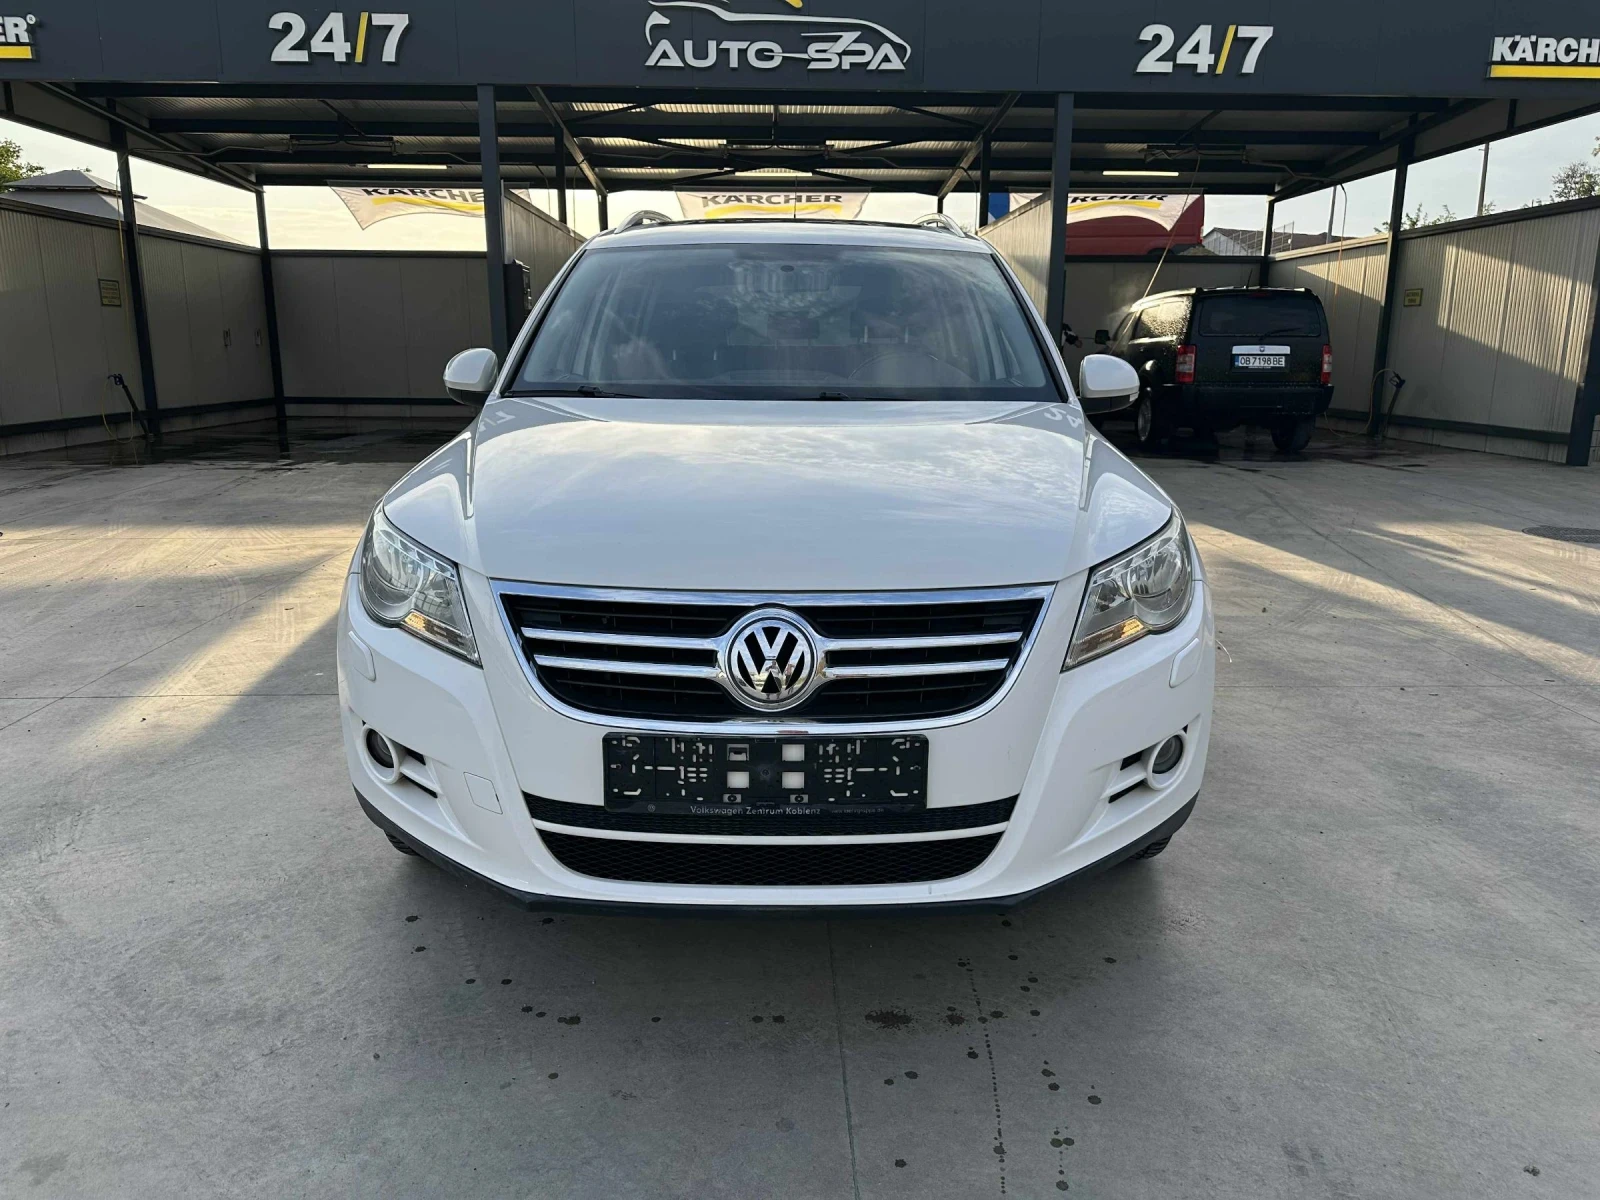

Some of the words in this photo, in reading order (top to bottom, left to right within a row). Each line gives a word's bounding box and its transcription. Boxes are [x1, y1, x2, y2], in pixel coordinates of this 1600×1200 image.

[269, 12, 410, 63] 24/7
[644, 38, 783, 69] AUTO
[806, 33, 908, 70] SPA
[1136, 24, 1274, 75] 24/7
[1492, 35, 1600, 63] KÄRCH
[702, 194, 843, 207] KÄRCHER
[690, 805, 744, 816] Volkswagen
[745, 806, 783, 815] Zentrum
[785, 806, 821, 815] Koblenz
